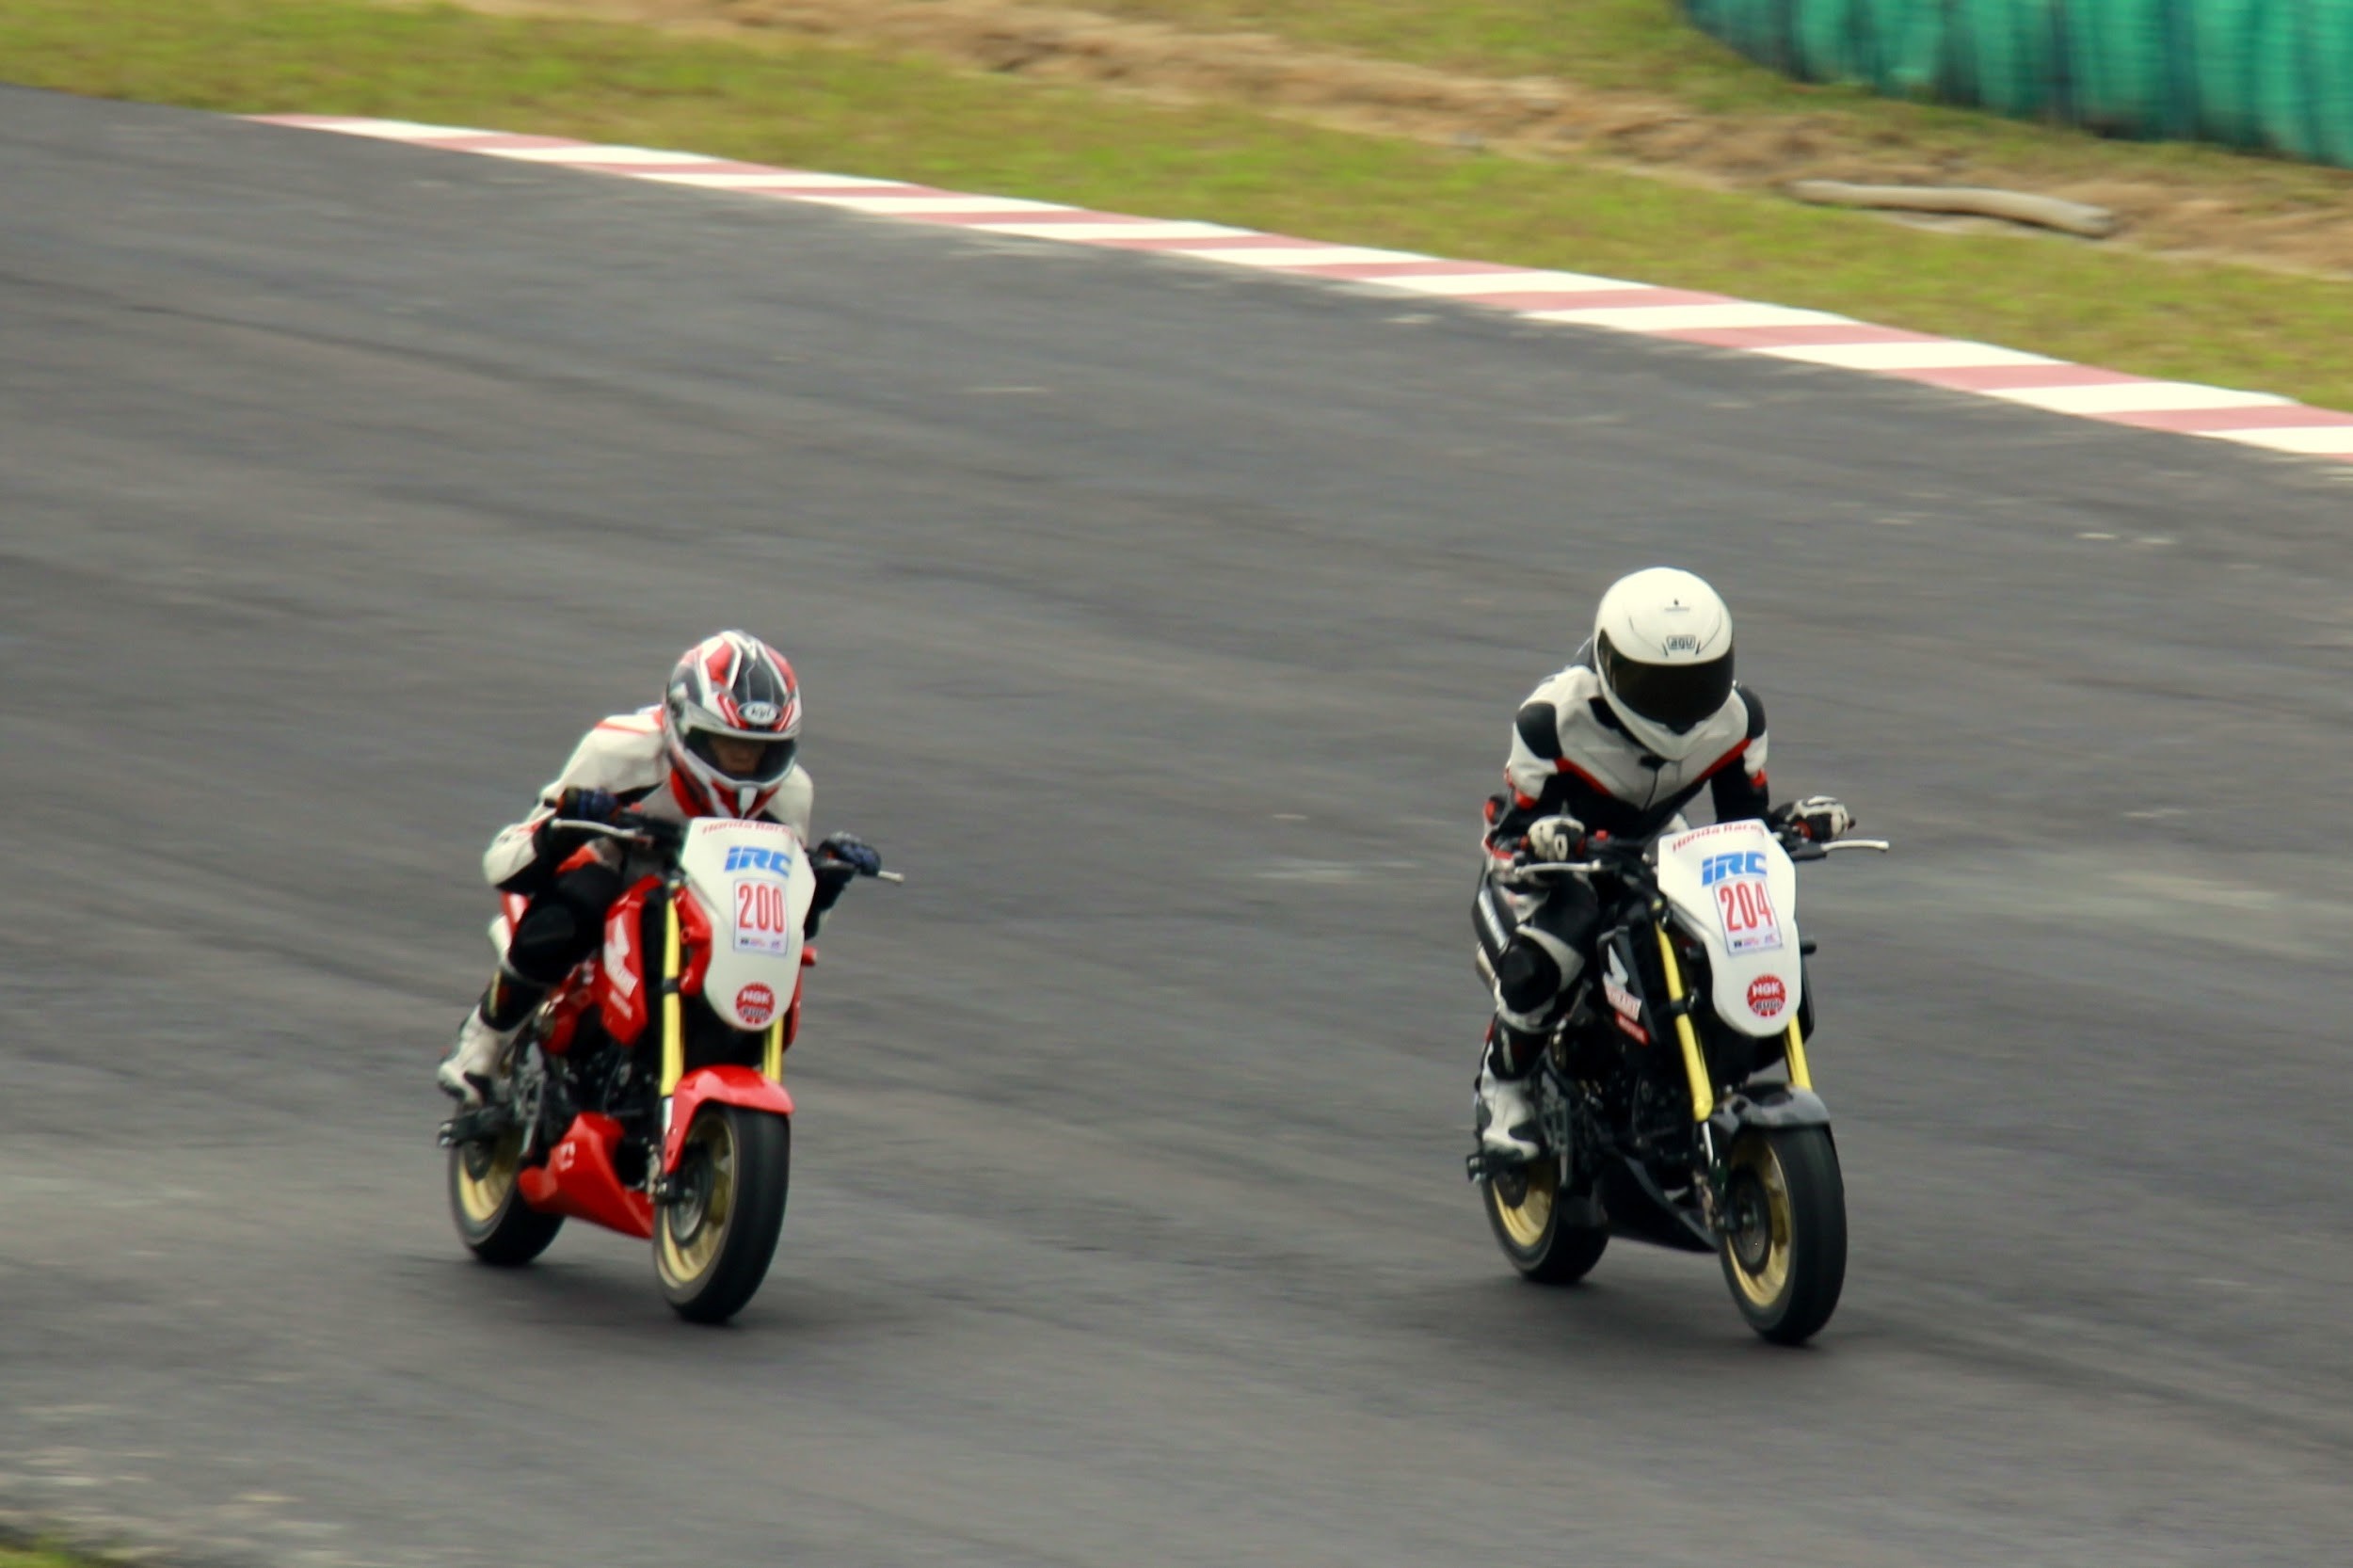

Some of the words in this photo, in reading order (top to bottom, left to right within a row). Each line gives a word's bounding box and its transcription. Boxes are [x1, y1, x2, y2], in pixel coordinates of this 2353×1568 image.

[739, 883, 785, 934] 200
[1720, 881, 1773, 932] 204
[743, 989, 770, 1004] NGK
[1753, 982, 1781, 998] NGK
